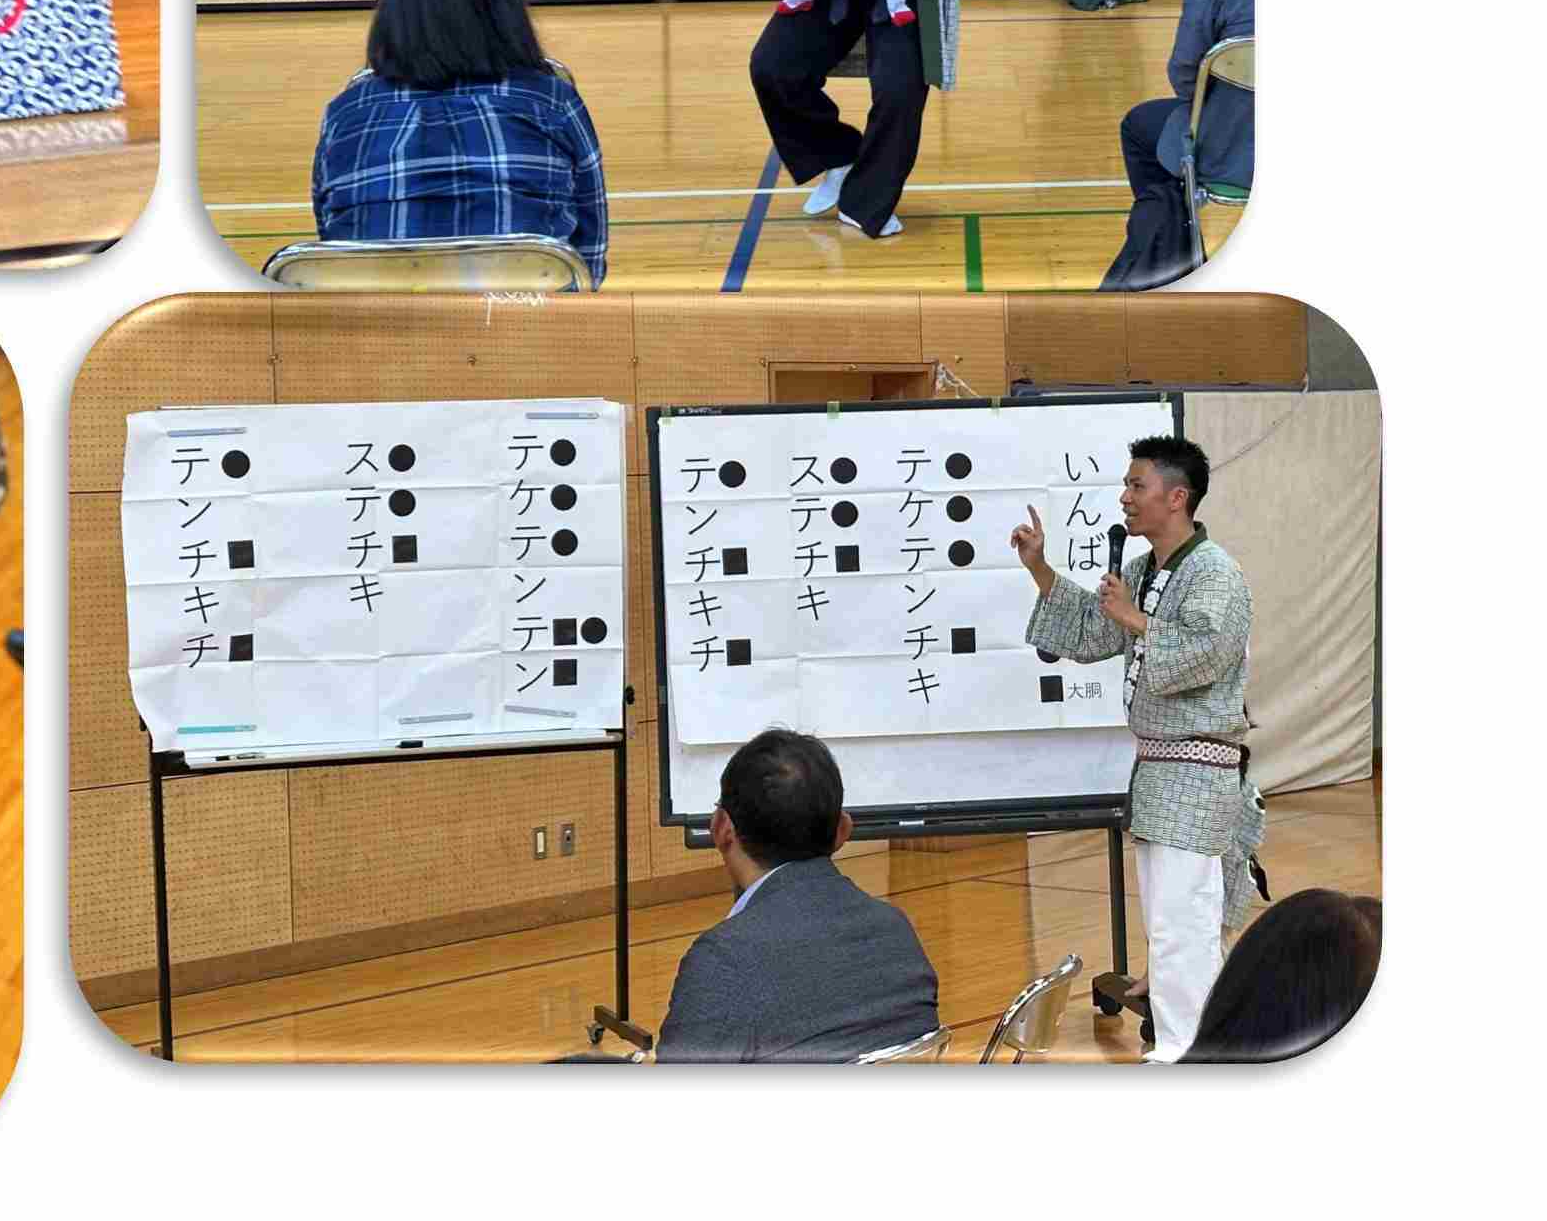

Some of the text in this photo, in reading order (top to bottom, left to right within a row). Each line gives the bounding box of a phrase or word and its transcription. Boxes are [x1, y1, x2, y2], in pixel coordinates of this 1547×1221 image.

[170, 446, 220, 670] テンチキチ
[344, 441, 386, 614] ステチキ
[507, 434, 550, 693] テケテンテン
[680, 457, 726, 673] テンチキチ
[790, 454, 831, 623] ステチキ
[896, 447, 941, 705] テケテンチキ
[1064, 453, 1105, 572] いんば
[1067, 682, 1102, 699] 大胴
